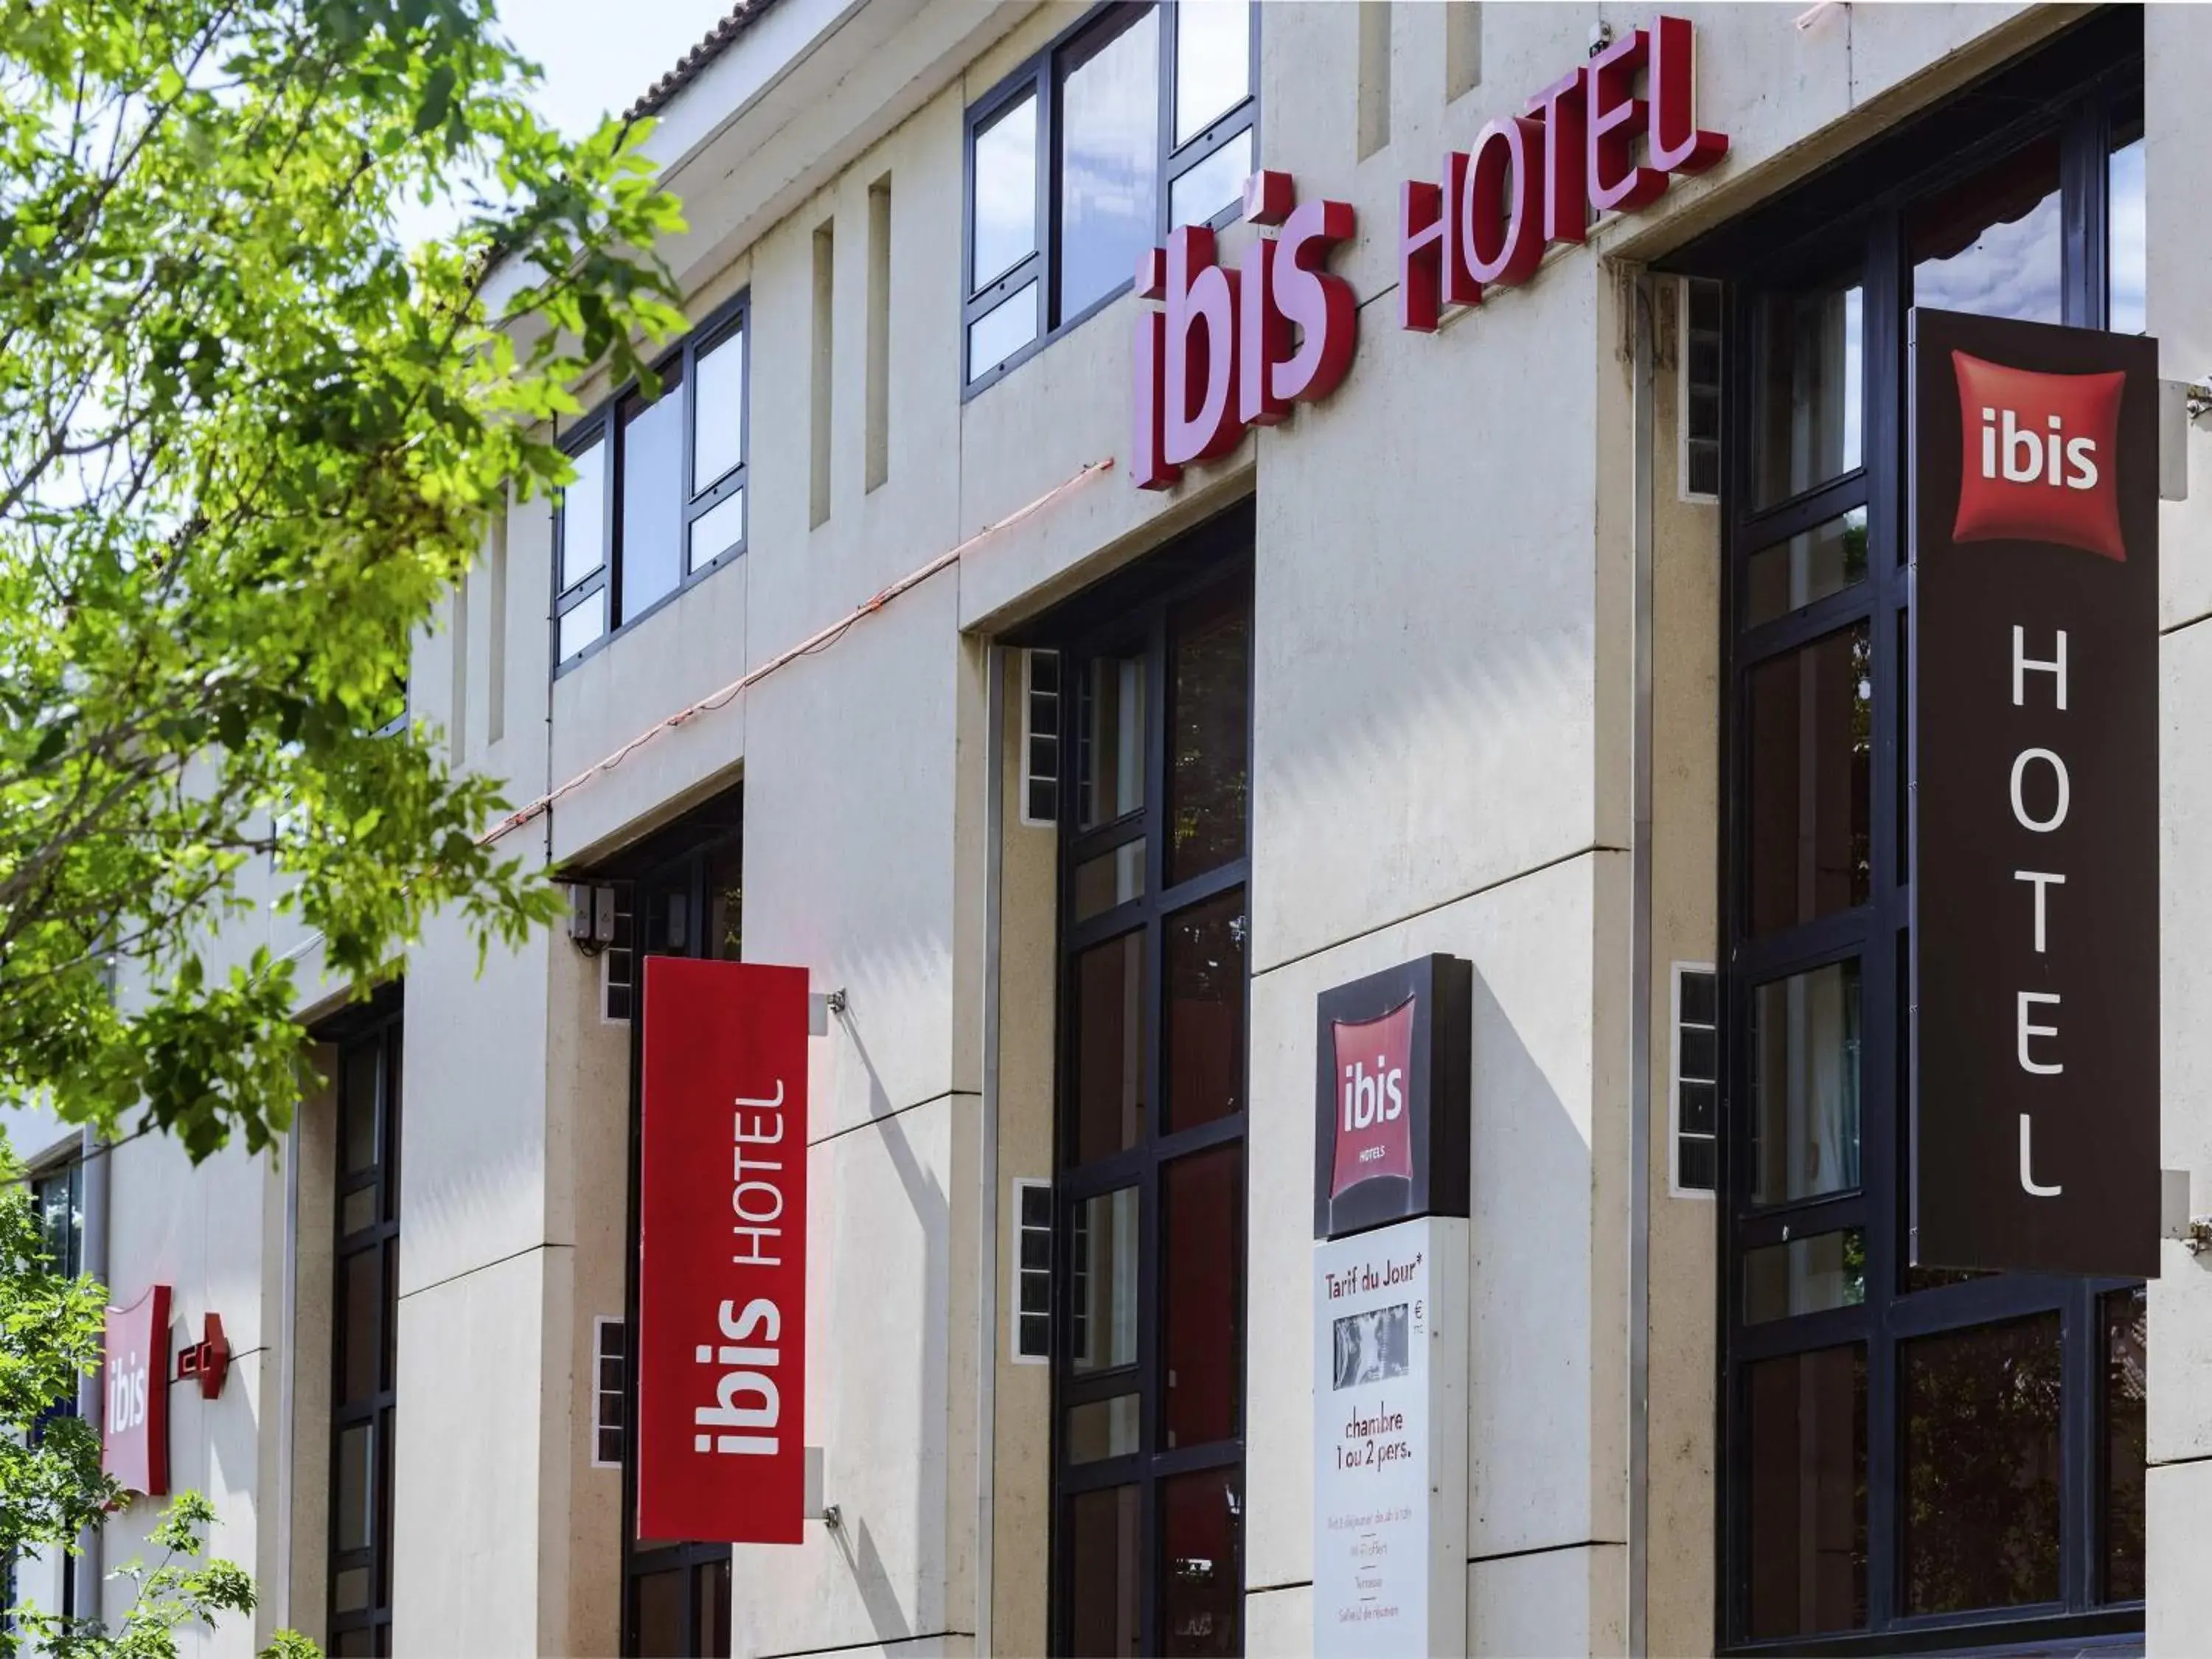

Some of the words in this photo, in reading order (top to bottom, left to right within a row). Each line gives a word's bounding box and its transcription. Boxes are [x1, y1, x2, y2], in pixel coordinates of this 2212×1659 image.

[1133, 170, 1357, 492] ibis
[1398, 15, 1728, 333] HOTEL
[1982, 406, 2098, 490] ibis
[2009, 625, 2070, 1197] HOTEL
[1343, 1054, 1402, 1132] ibis
[731, 1078, 783, 1266] HOTEL
[1359, 1145, 1385, 1164] HOTELS
[1325, 1265, 1358, 1300] Tarif
[1362, 1262, 1379, 1291] du
[109, 1351, 145, 1434] ibis
[695, 1298, 782, 1455] ibis
[1346, 1400, 1403, 1439] chambre
[1346, 1450, 1362, 1468] ou
[1366, 1439, 1374, 1465] 2
[1377, 1441, 1411, 1472] pers.
